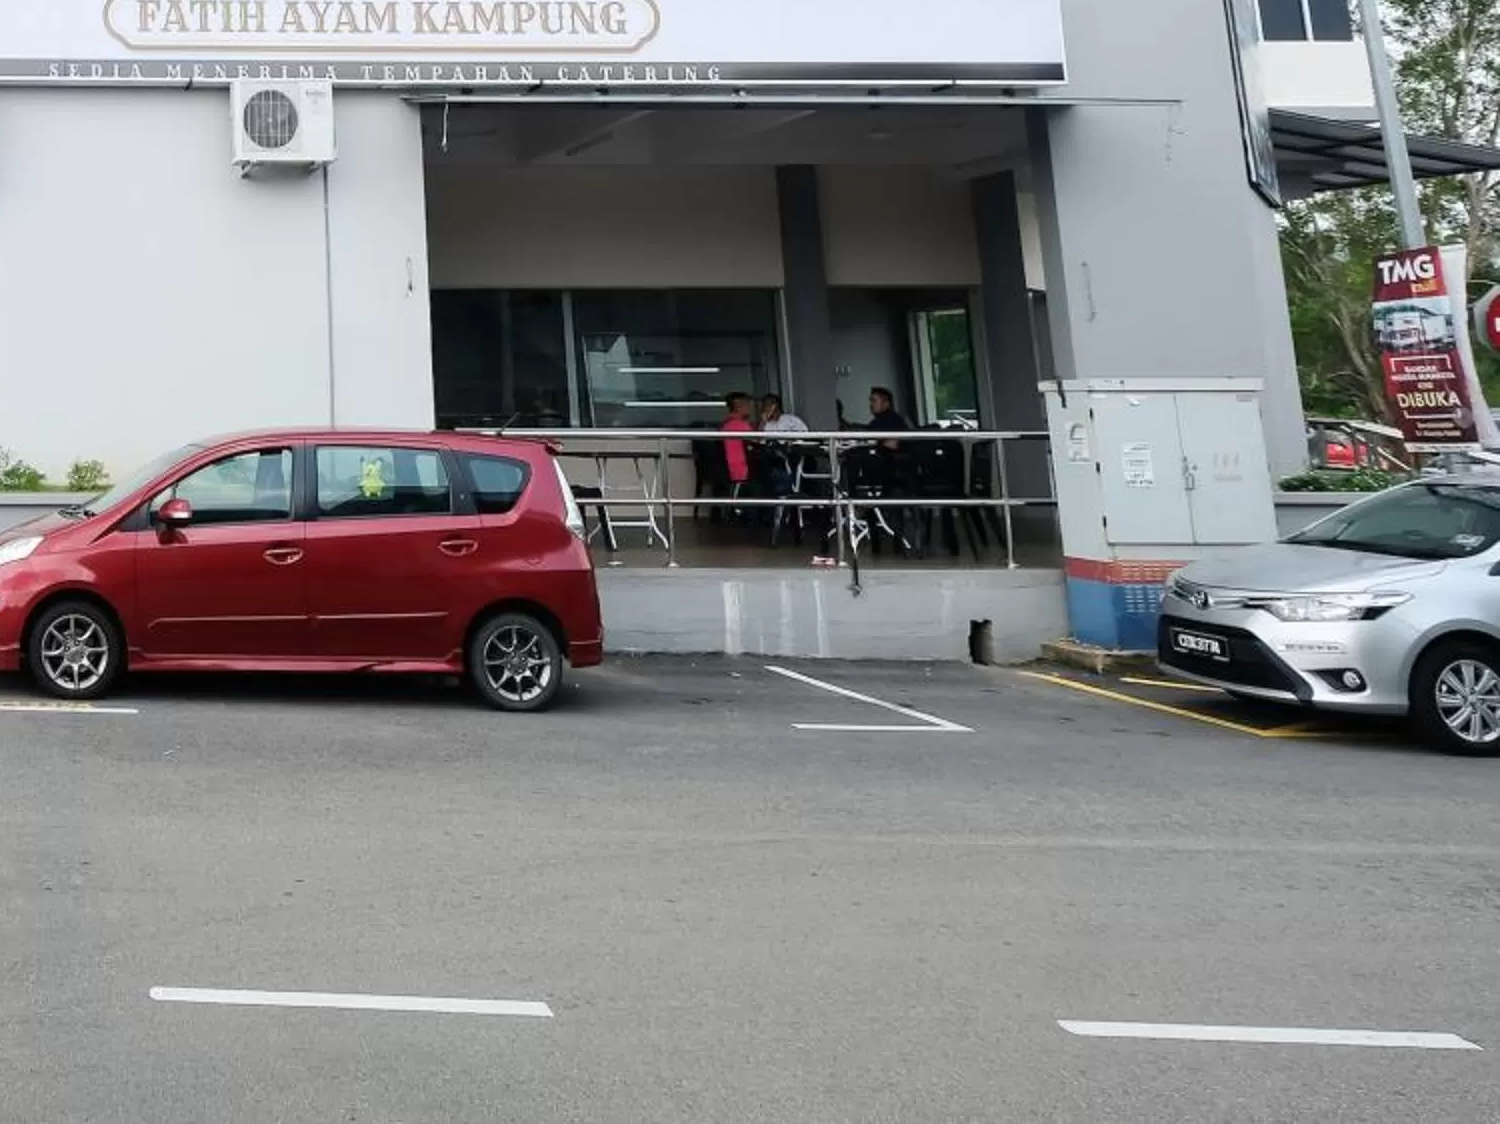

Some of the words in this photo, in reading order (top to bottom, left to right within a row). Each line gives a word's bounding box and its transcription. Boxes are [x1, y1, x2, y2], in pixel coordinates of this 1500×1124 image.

[136, 0, 267, 33] FATIH
[277, 1, 400, 33] AYAM
[412, 1, 627, 34] KAMPUNG
[49, 63, 143, 77] SEDIA
[166, 63, 337, 79] MENERIMA
[361, 65, 532, 80] TEMPAHAN
[558, 65, 720, 80] CATERING
[1377, 253, 1435, 285] TMG
[1396, 391, 1462, 408] DIBUKA
